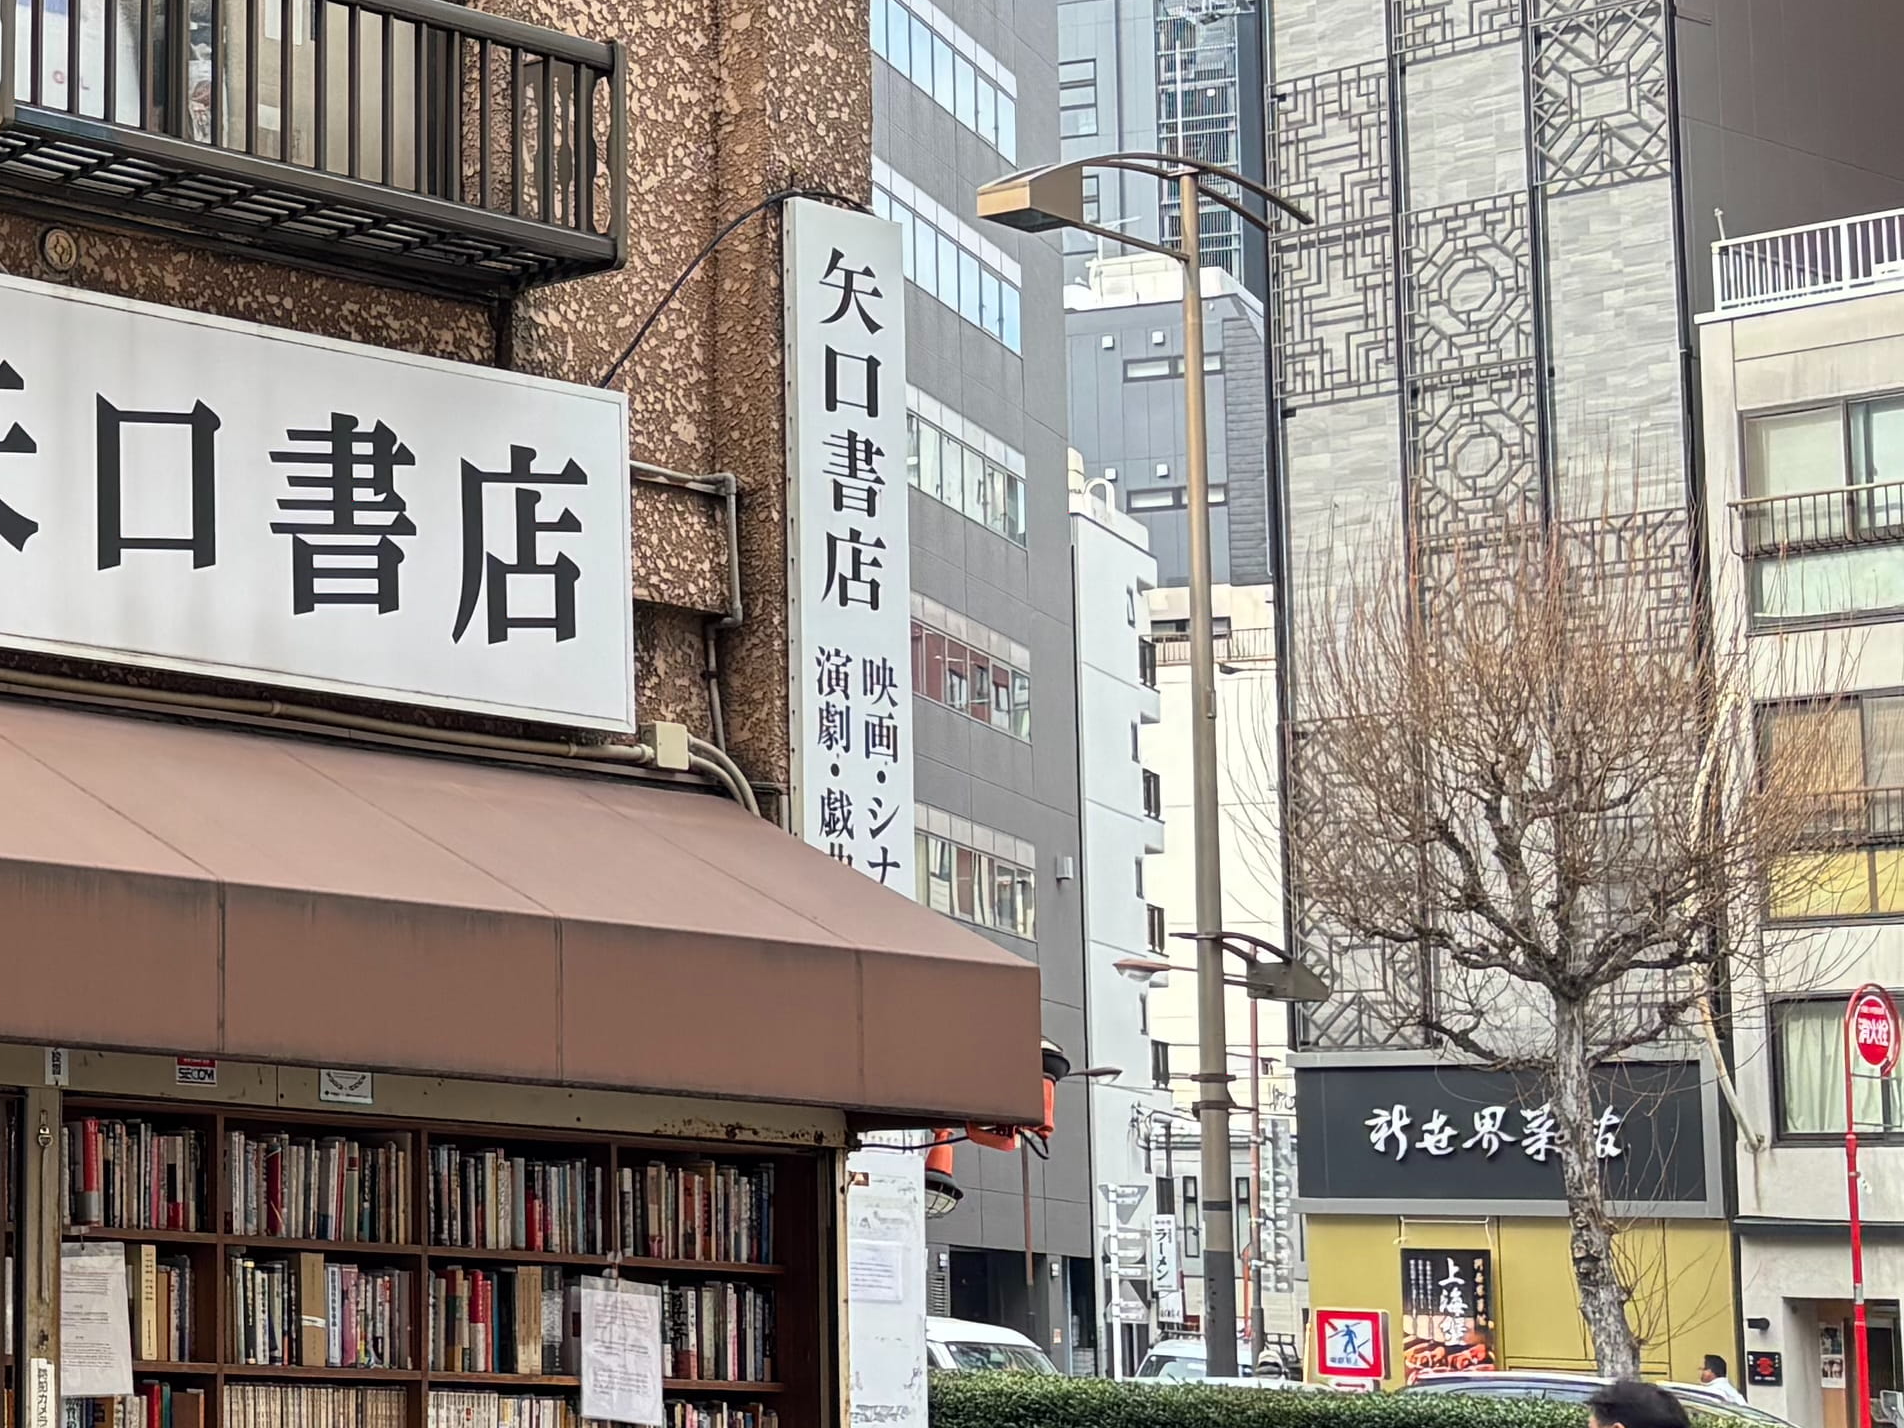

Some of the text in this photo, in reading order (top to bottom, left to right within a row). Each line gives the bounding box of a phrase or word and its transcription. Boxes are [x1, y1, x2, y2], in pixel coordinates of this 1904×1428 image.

[818, 247, 886, 613] 矢口書店
[178, 1067, 215, 1081] SECOM
[1154, 1229, 1169, 1281] ラーメン
